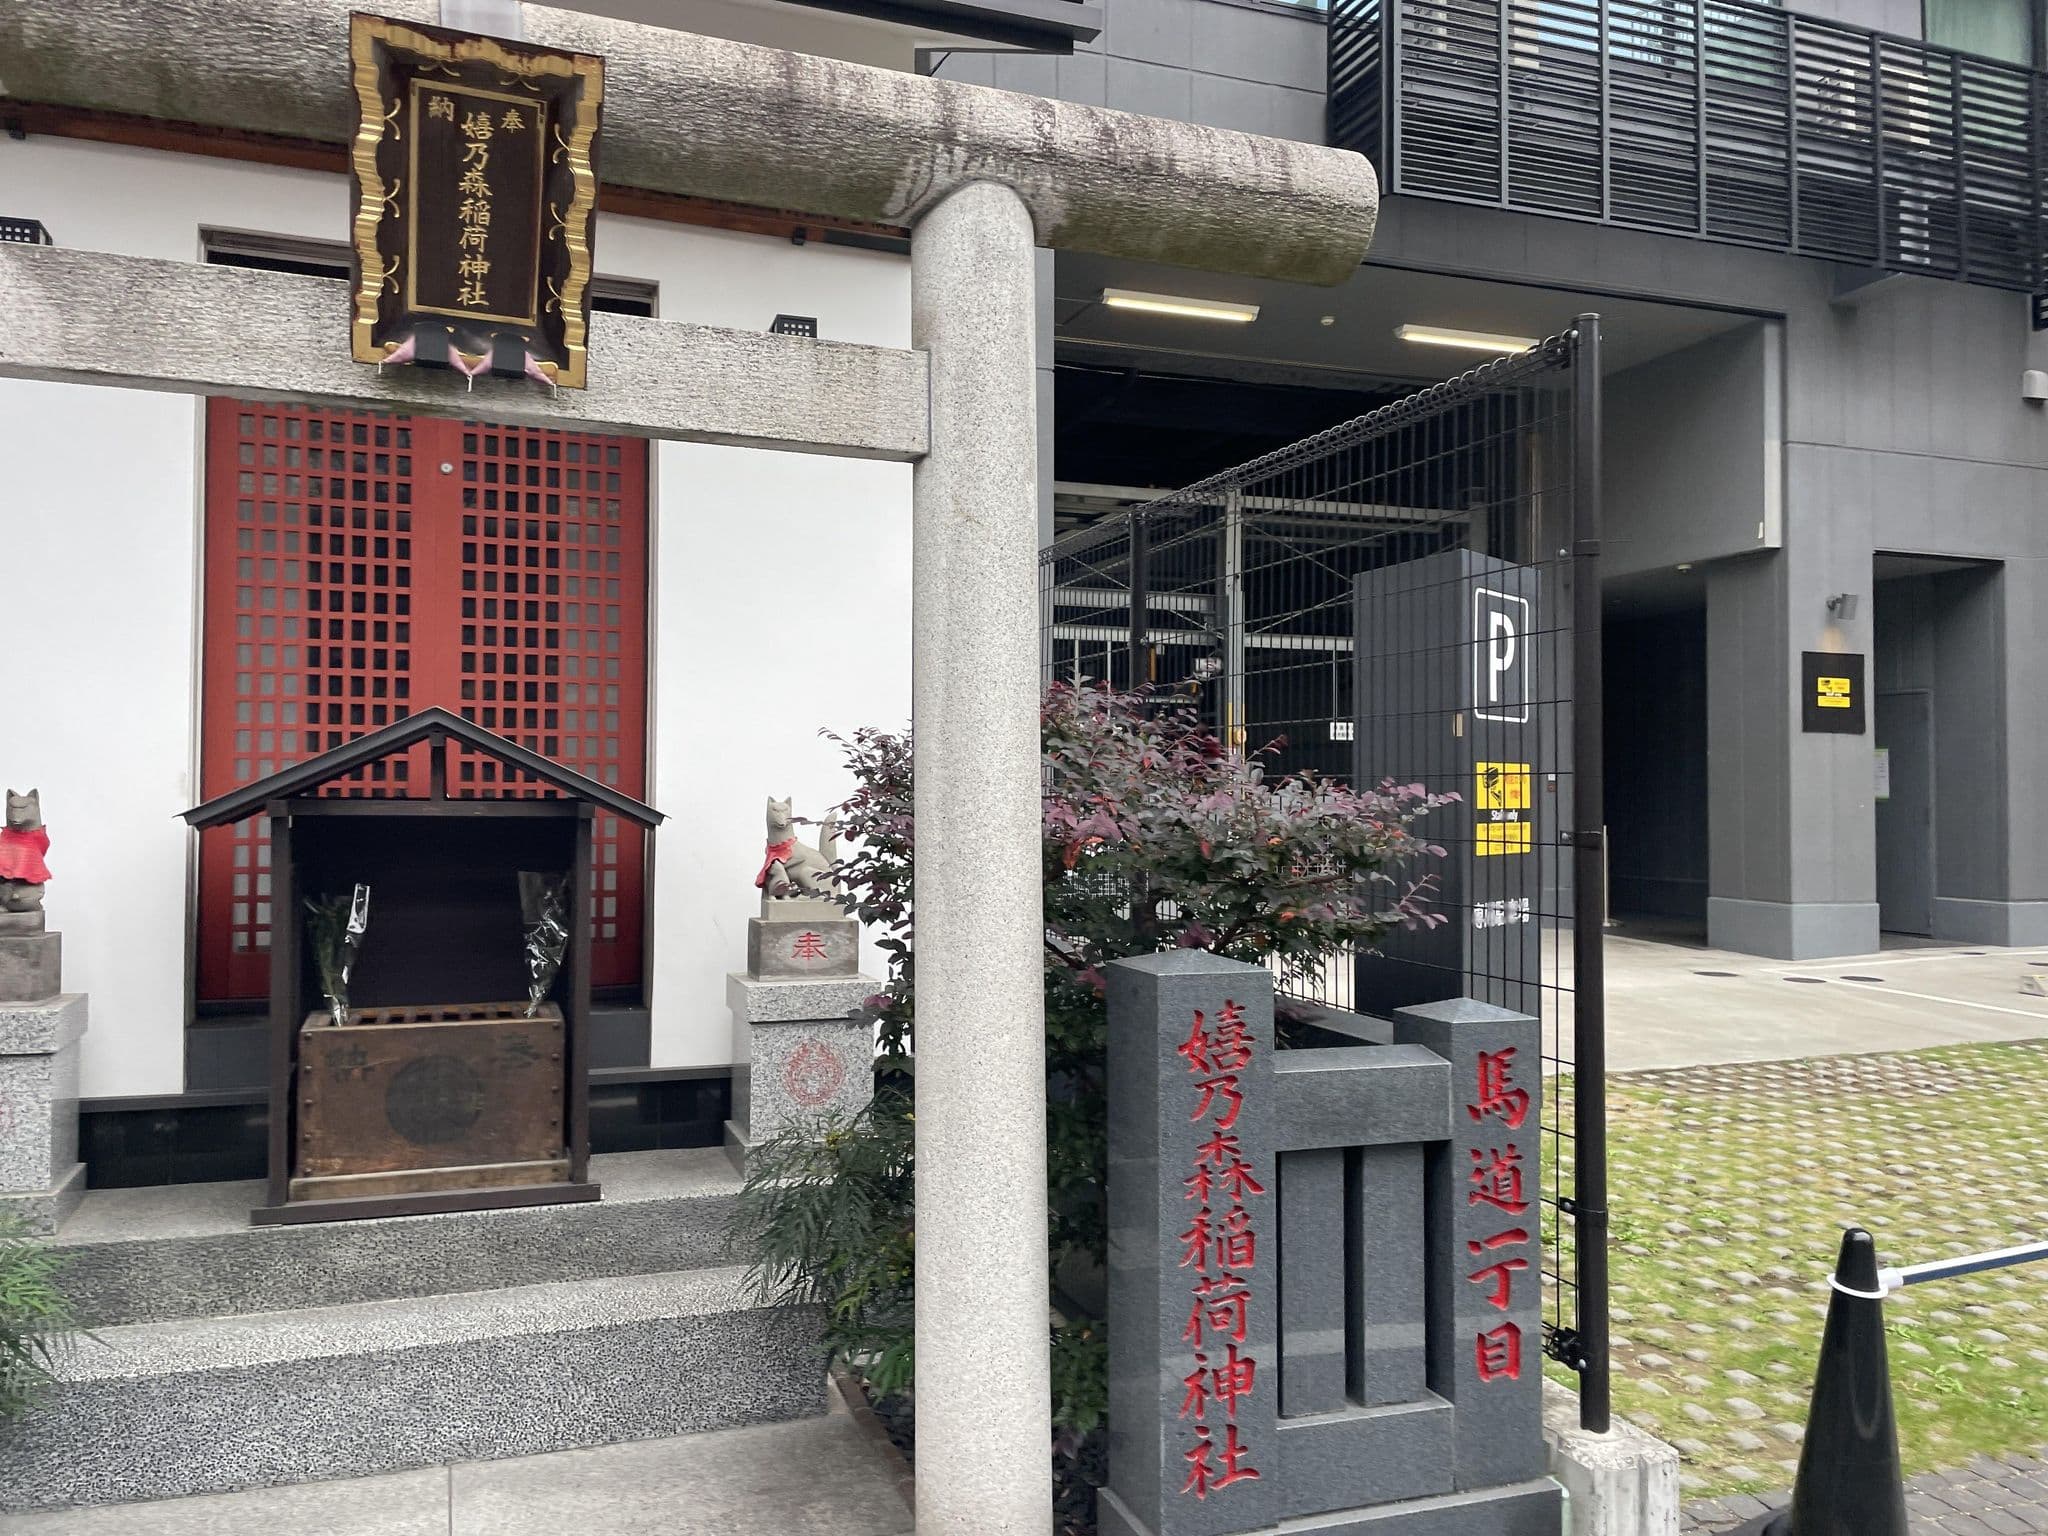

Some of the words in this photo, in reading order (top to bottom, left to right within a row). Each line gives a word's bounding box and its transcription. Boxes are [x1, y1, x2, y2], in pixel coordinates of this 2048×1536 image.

[500, 108, 526, 133] 奉
[456, 111, 495, 307] 嬉乃森稲荷神社
[1489, 610, 1515, 702] P
[790, 931, 828, 961] 奉
[1178, 999, 1265, 1500] 嬉乃森稲荷神社
[1467, 1046, 1530, 1383] 馬道一丁目
